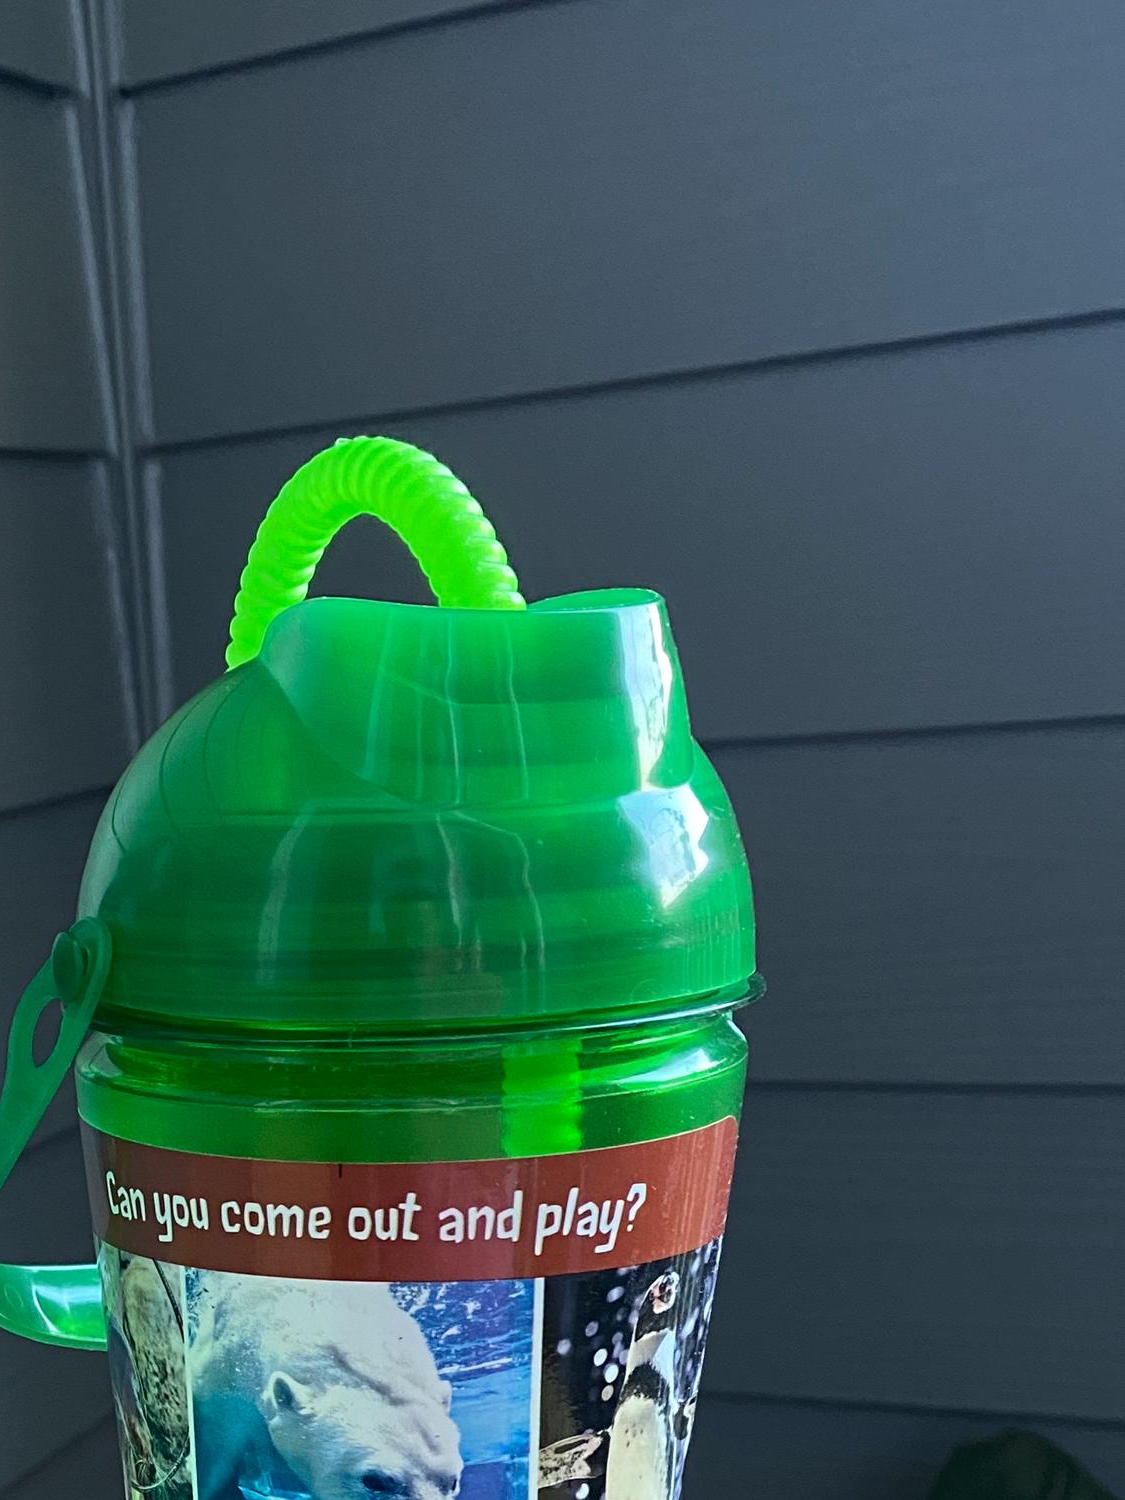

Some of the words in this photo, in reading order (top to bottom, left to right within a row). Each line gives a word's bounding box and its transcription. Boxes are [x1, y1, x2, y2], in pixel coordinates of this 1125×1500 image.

[106, 1170, 146, 1221] Can
[154, 1189, 209, 1243] you
[221, 1199, 331, 1240] come
[347, 1192, 422, 1242] out
[439, 1190, 522, 1243] and
[534, 1182, 647, 1256] play?
